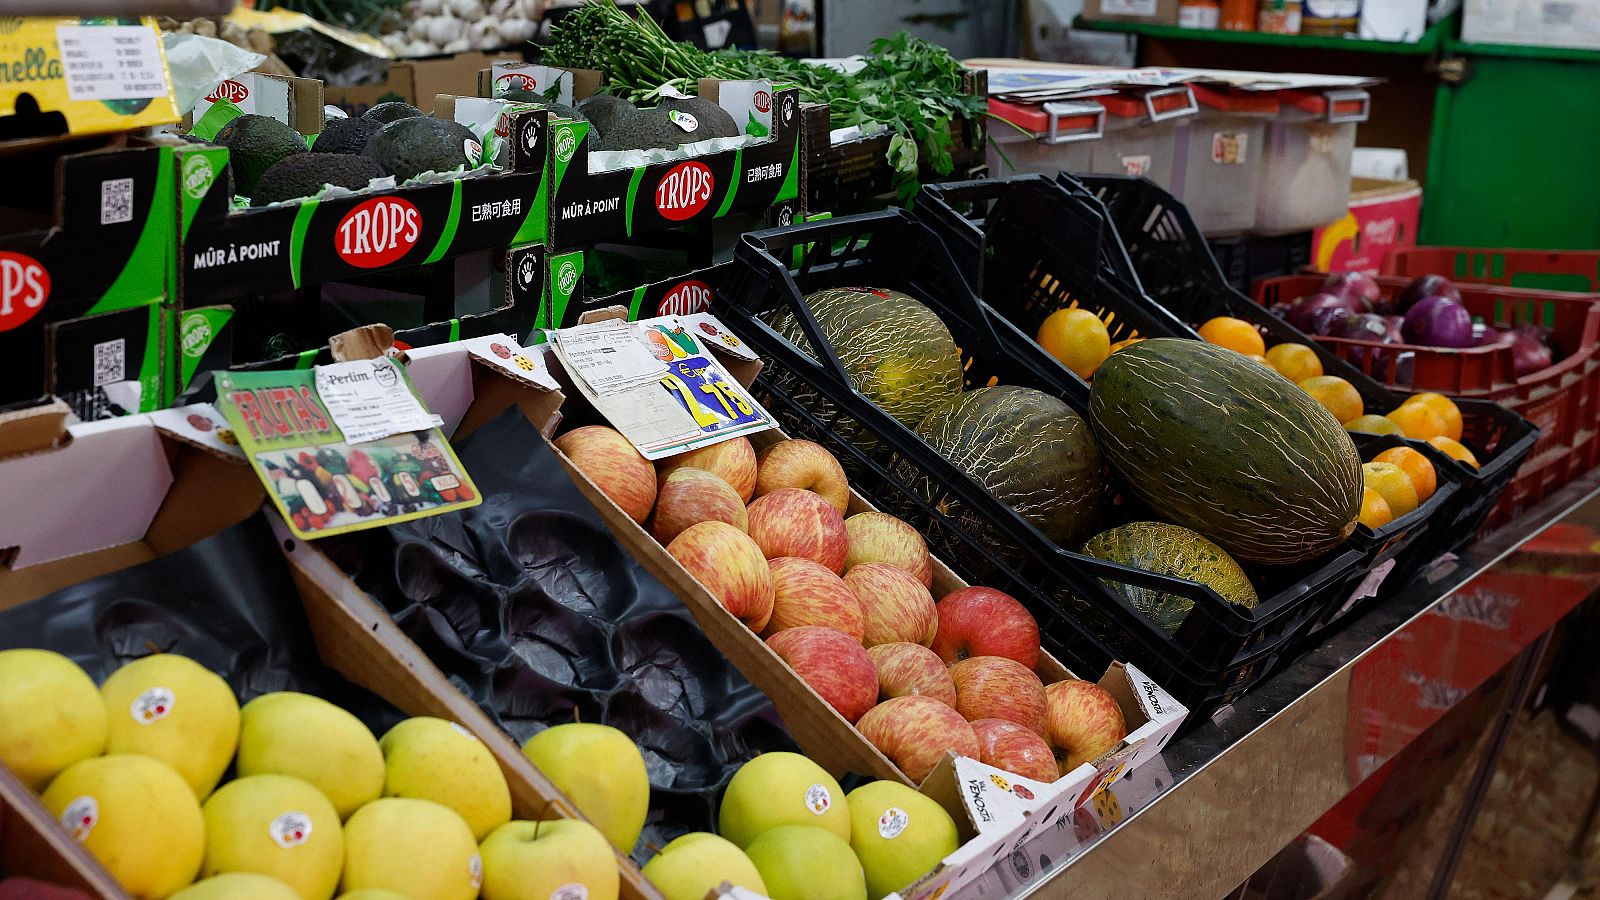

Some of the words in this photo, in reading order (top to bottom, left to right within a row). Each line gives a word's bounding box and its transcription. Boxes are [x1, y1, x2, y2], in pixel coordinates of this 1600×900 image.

[658, 166, 711, 209] TROPS
[471, 198, 521, 222] 已熟可食用
[562, 201, 583, 220] MÛR
[584, 201, 592, 216] À
[592, 197, 620, 214] POINT
[341, 202, 418, 254] TROPS
[193, 247, 226, 270] MÛR
[227, 244, 238, 263] À
[239, 240, 280, 262] POINT
[329, 372, 369, 385] Perlim
[230, 385, 330, 440] FRUTAS
[1142, 680, 1164, 715] VENOSTA
[968, 779, 991, 822] VENOSTA
